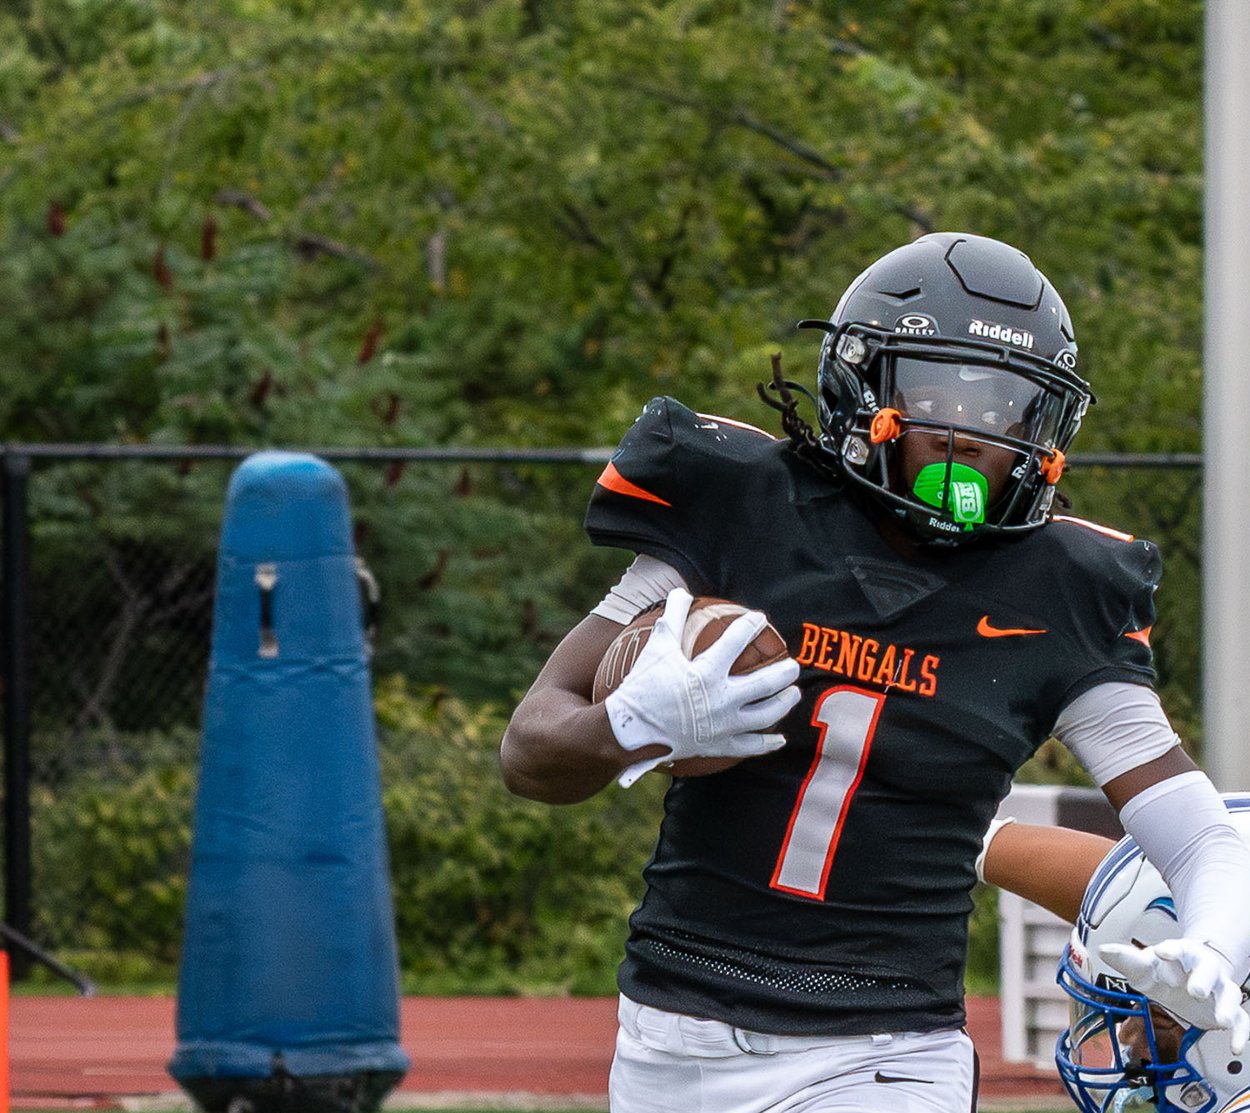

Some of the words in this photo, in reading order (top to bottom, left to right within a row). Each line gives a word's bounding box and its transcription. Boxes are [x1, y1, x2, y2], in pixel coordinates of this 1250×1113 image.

[968, 319, 1034, 349] Riddell
[796, 622, 940, 697] BENGALS
[769, 684, 886, 901] 1
